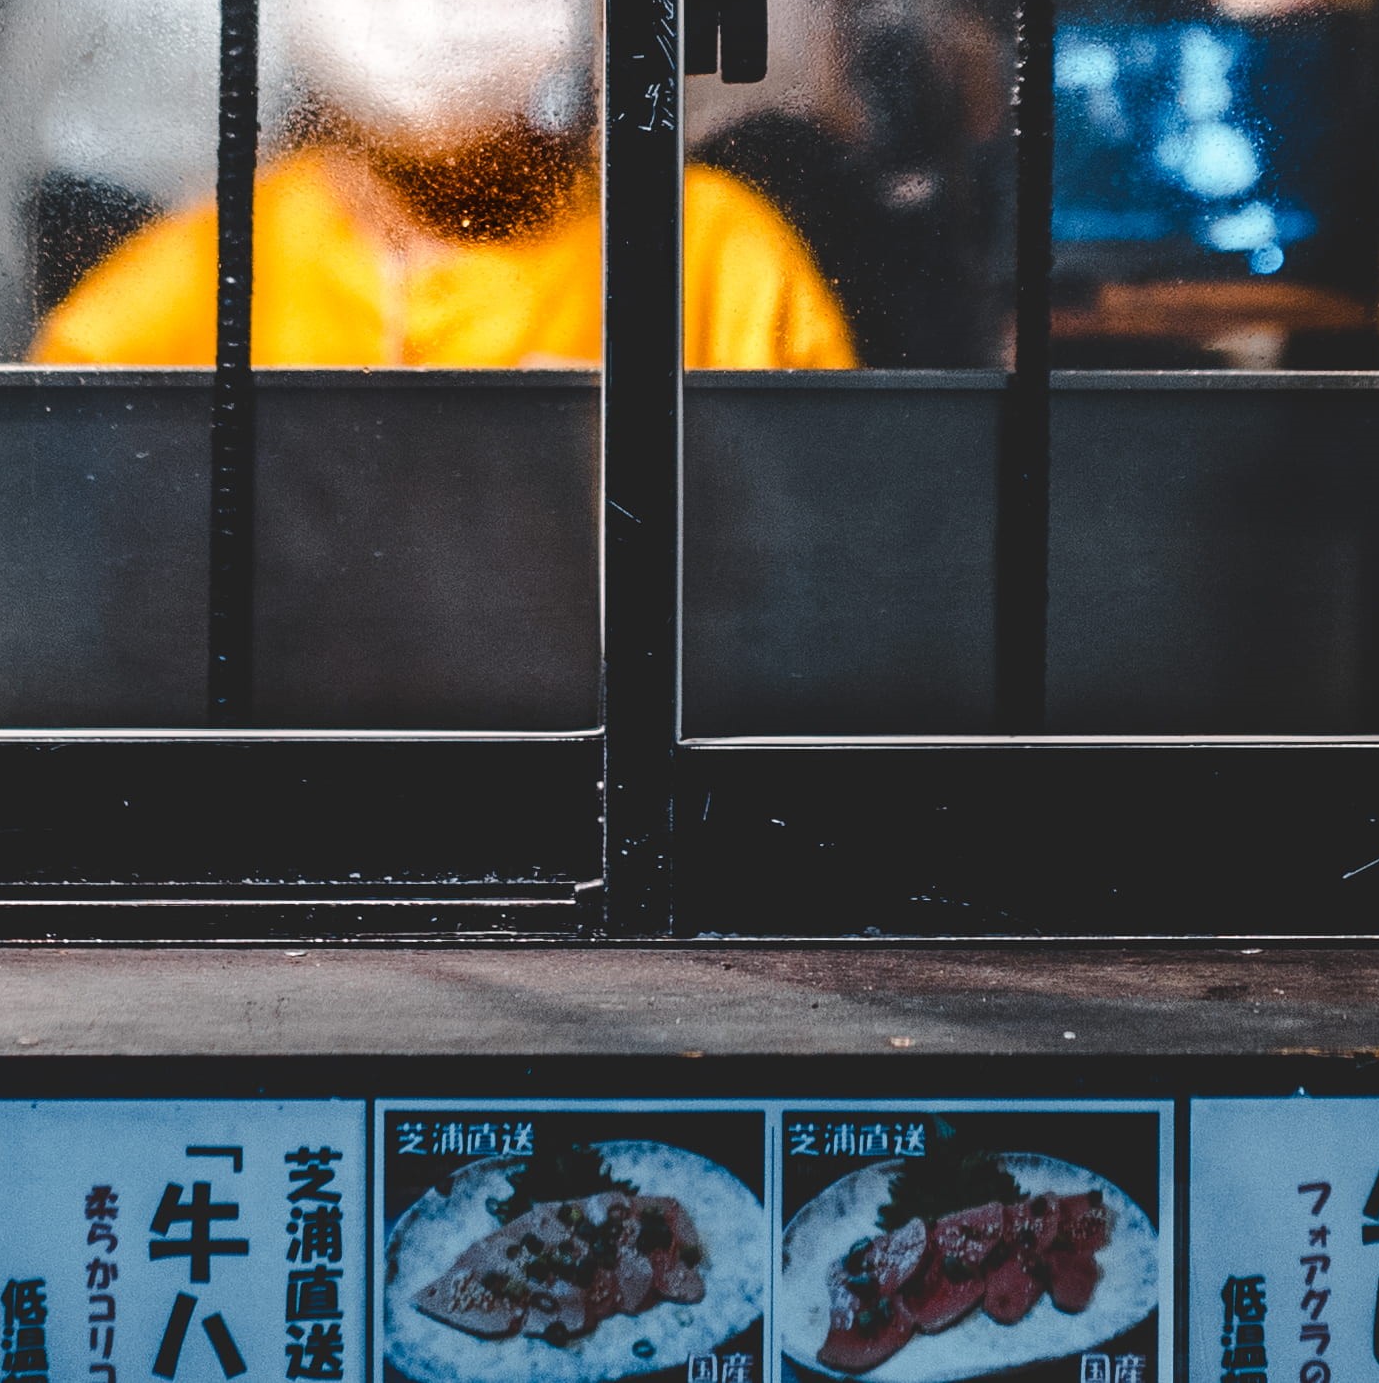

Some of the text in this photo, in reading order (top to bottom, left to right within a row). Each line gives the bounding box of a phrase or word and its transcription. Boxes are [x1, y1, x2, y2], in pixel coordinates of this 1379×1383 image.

[396, 1121, 535, 1156] 芝浦直送
[788, 1122, 927, 1157] 芝浦直送
[284, 1146, 344, 1381] 芝浦直送
[1, 1277, 49, 1383] 低温
[1220, 1273, 1268, 1383] 低温
[686, 1352, 754, 1383] 国産
[1080, 1352, 1146, 1383] 国産
